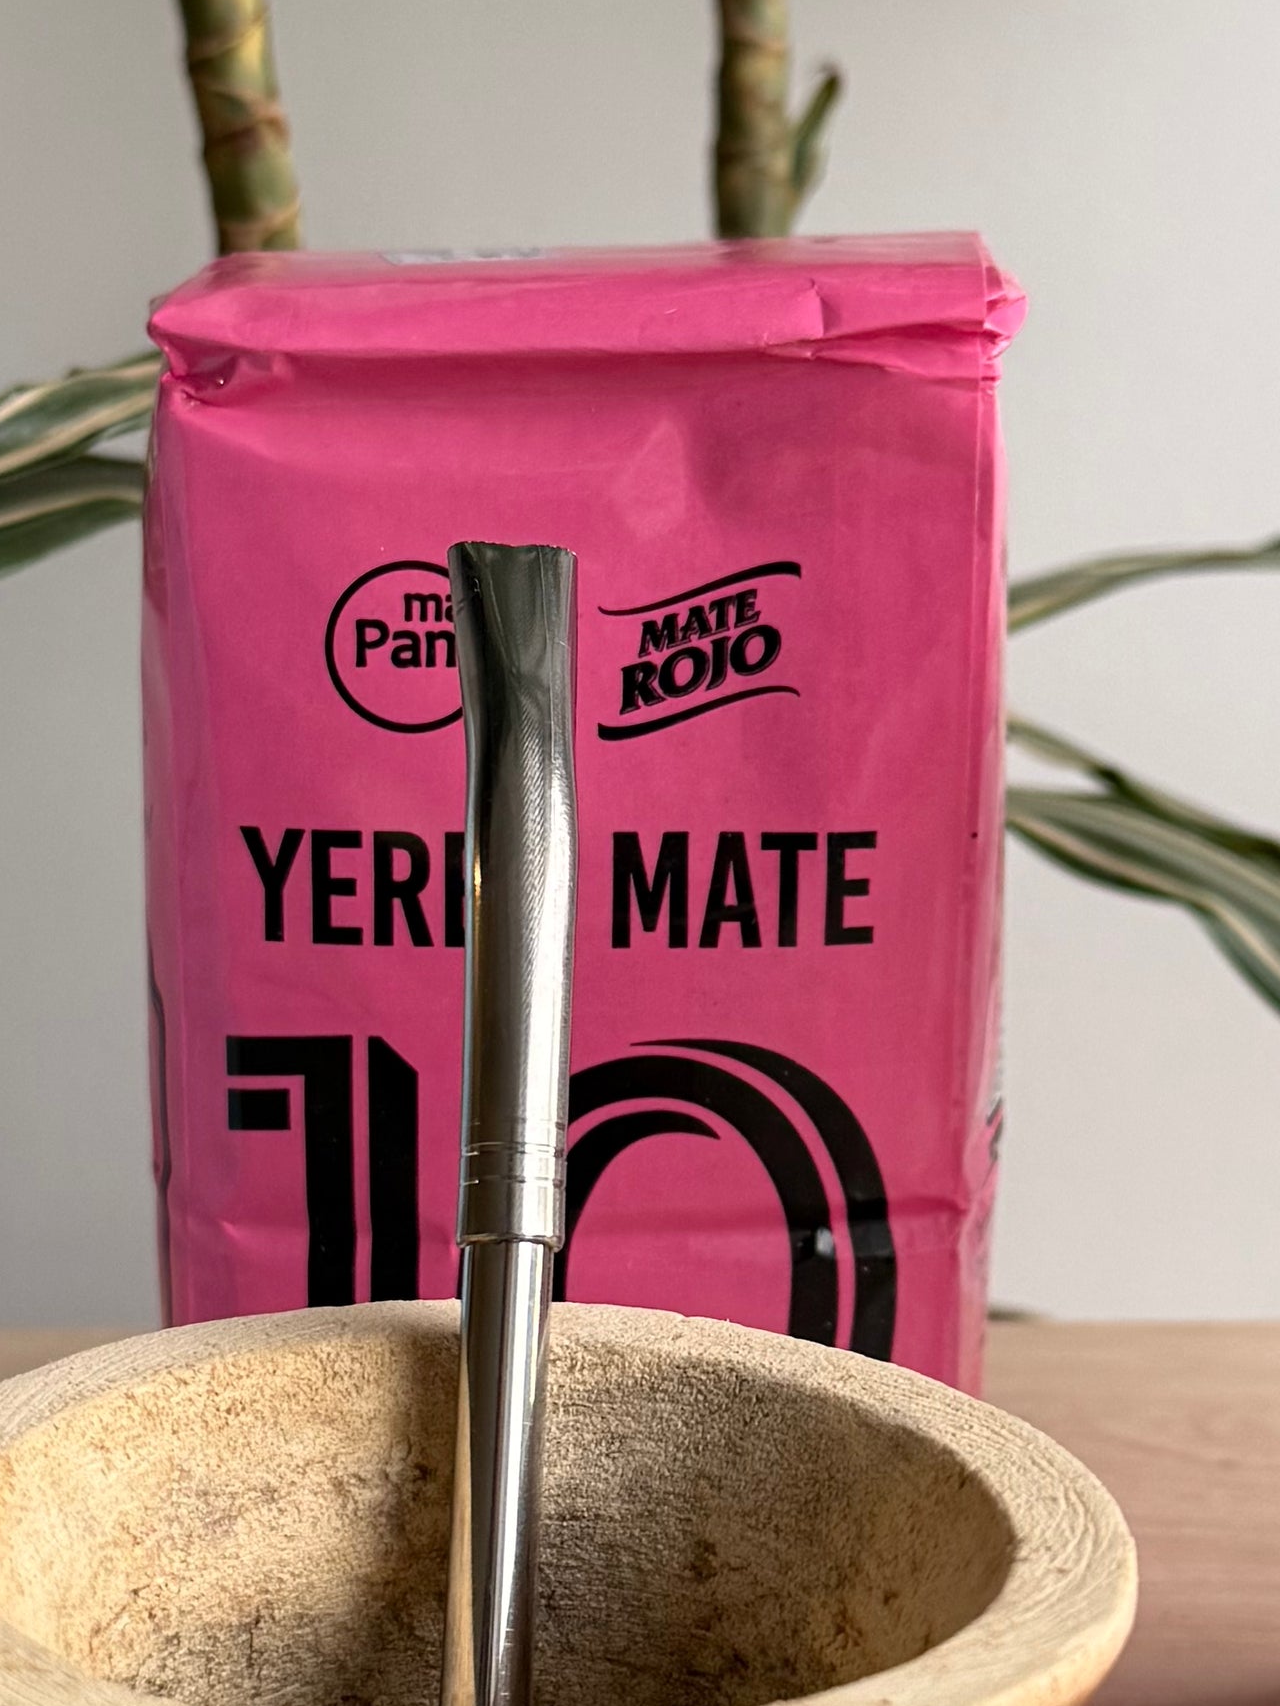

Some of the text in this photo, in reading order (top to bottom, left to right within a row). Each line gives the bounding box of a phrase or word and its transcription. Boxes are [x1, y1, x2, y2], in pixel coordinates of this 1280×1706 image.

[355, 619, 457, 668] Pan
[638, 589, 761, 658] MATE
[620, 625, 781, 715] ROJO
[240, 826, 877, 949] YER MATE
